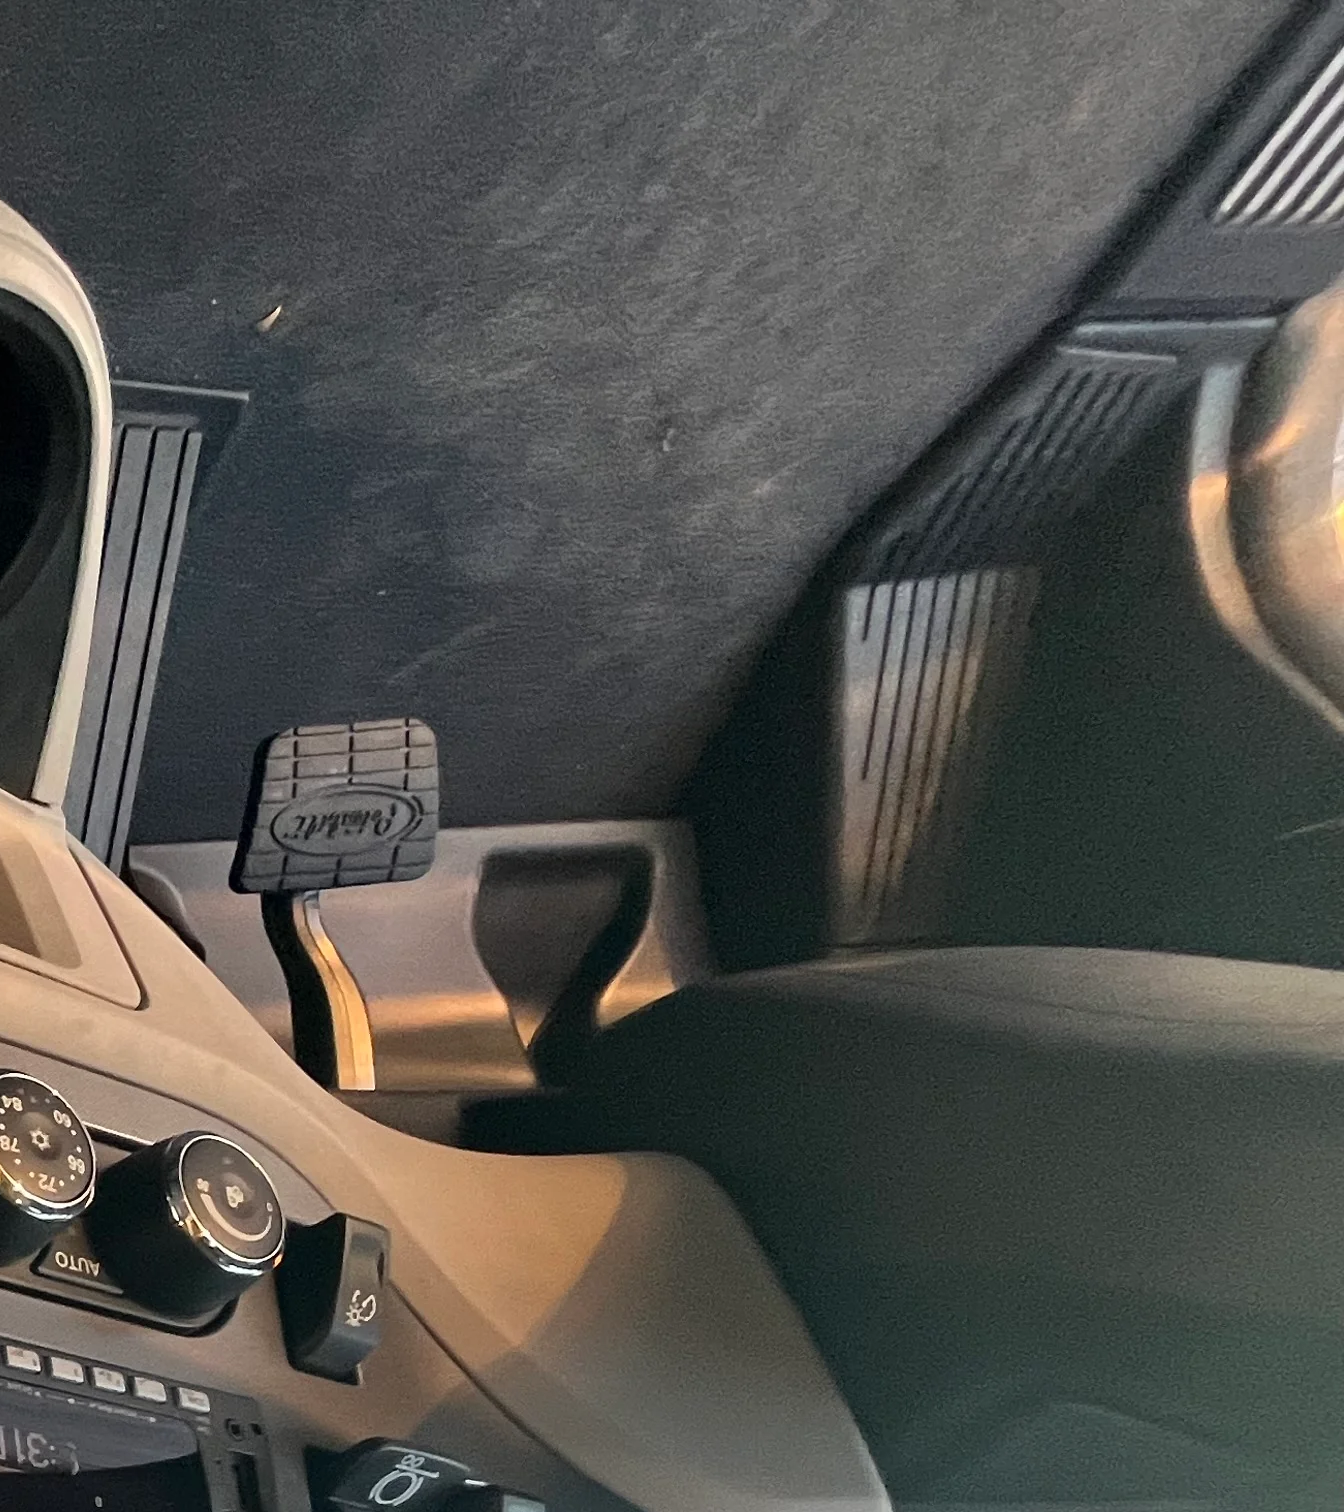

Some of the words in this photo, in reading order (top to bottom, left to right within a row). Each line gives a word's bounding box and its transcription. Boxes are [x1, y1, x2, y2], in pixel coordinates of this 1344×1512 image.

[0, 1095, 24, 1112] 84
[53, 1109, 72, 1128] 60
[37, 1173, 58, 1193] 72
[55, 1251, 100, 1276] AUTO
